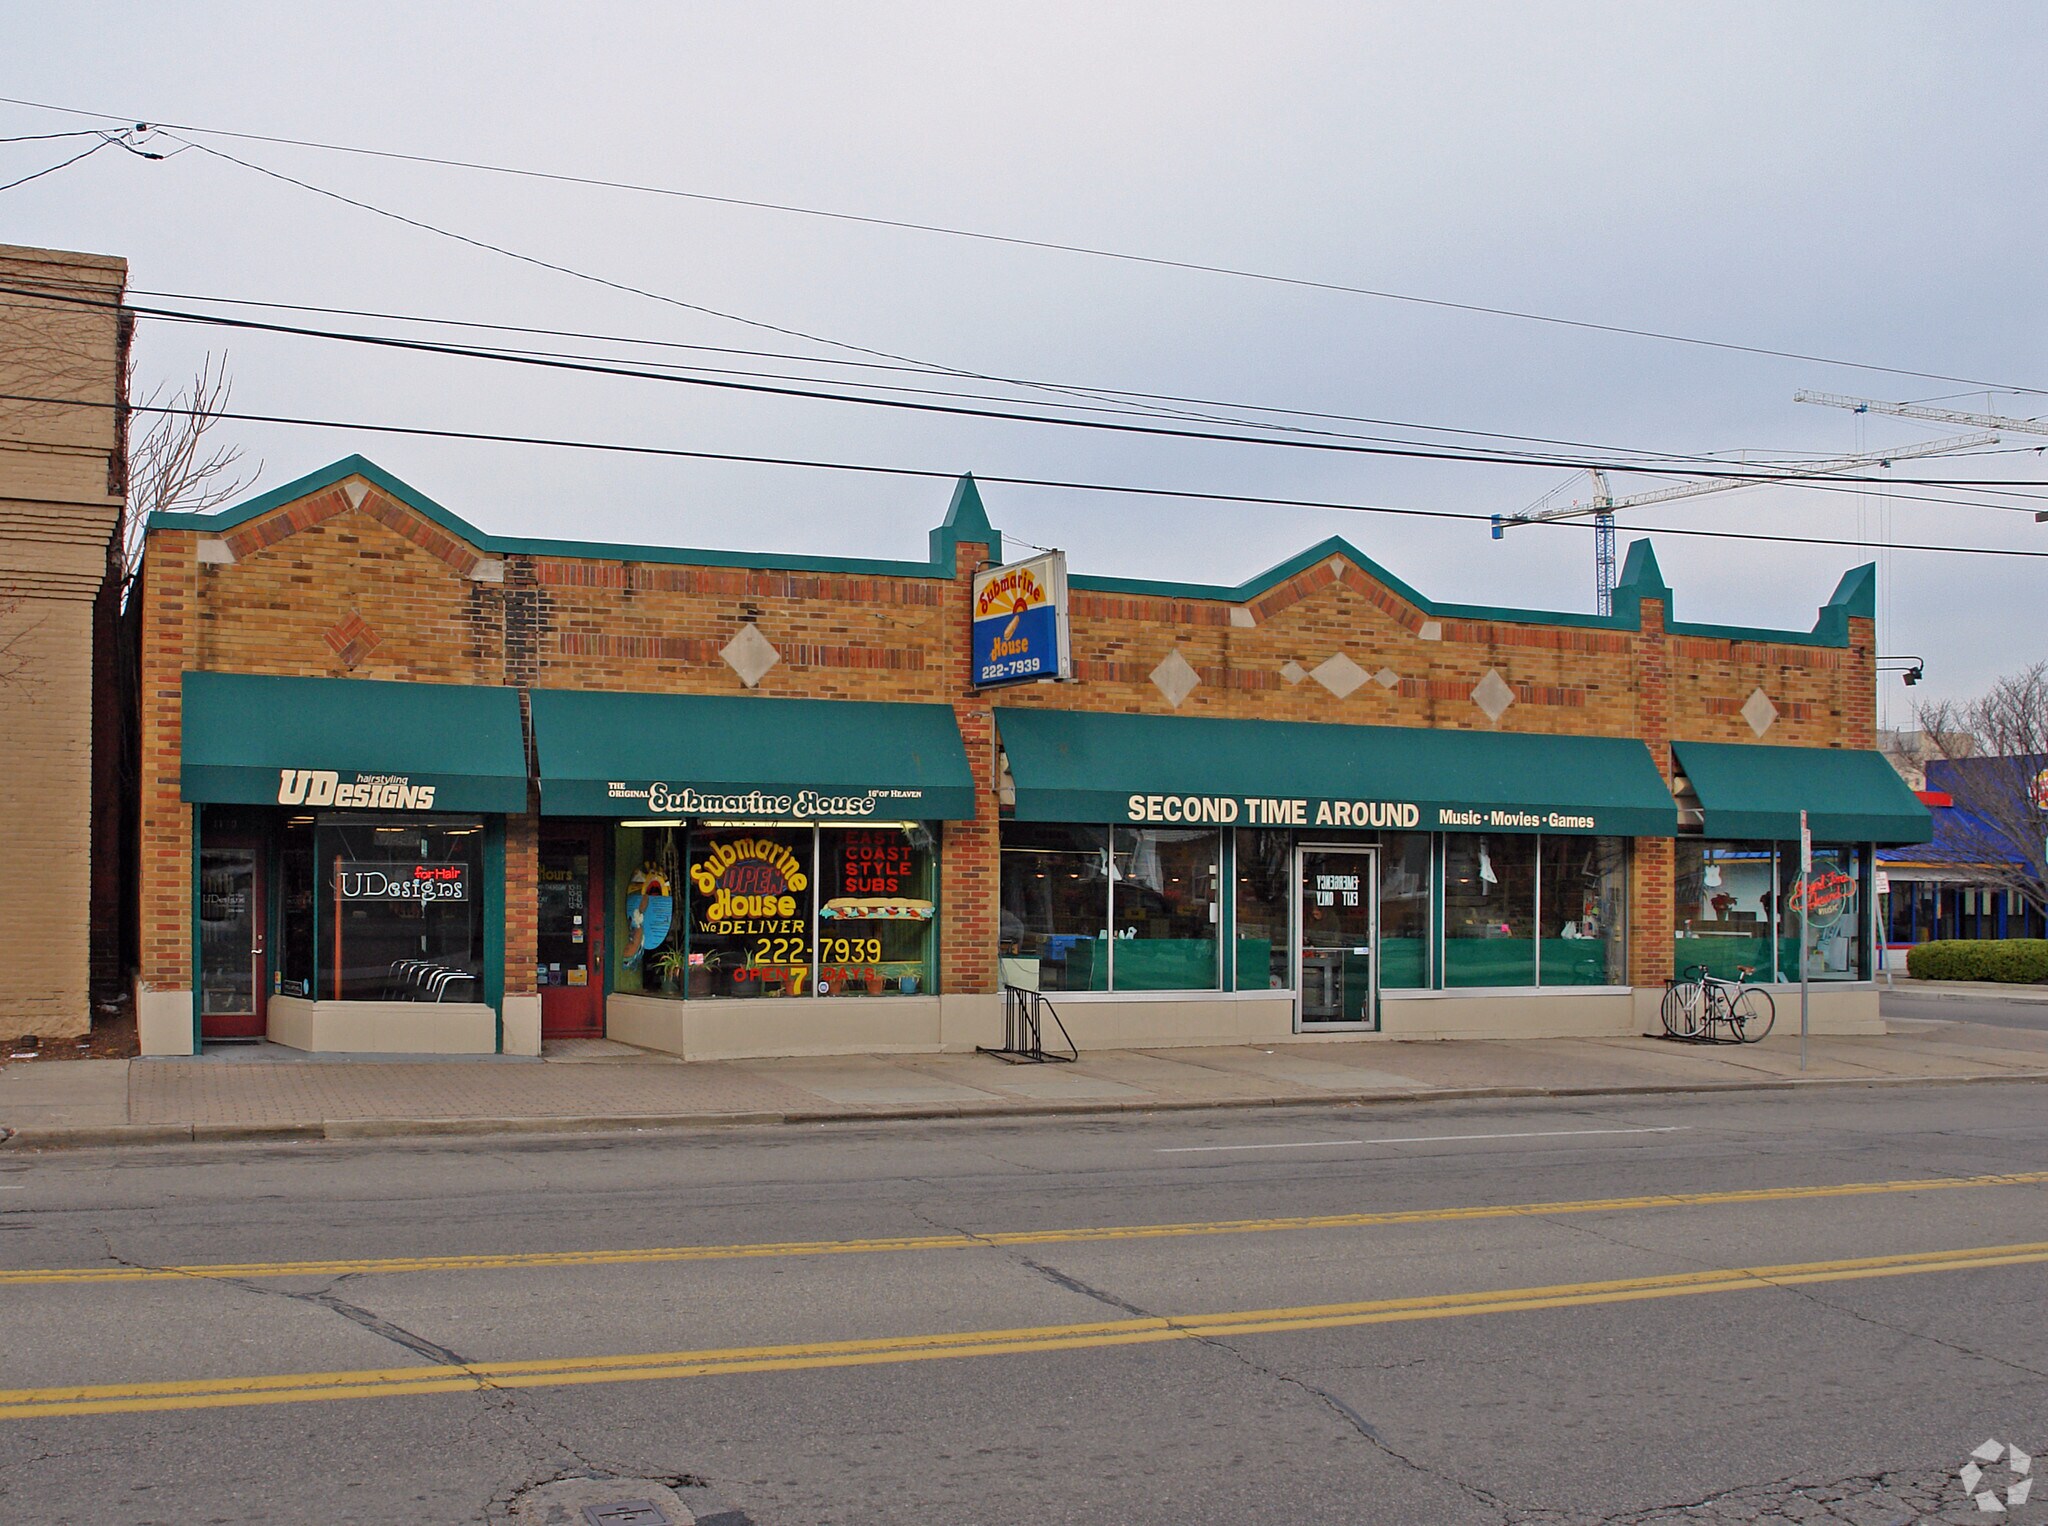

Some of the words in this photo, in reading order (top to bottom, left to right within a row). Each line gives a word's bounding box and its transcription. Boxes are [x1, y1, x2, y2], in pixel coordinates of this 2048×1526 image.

[979, 572, 1040, 614] Submarine
[991, 637, 1028, 661] House
[982, 657, 1040, 679] 222-7939
[356, 773, 409, 786] hairstyling
[608, 782, 626, 790] THE
[608, 790, 650, 798] ORIGINAL
[649, 781, 792, 814] Submarine
[792, 790, 876, 818] House
[890, 790, 922, 798] HEAVEN
[1127, 795, 1239, 823] SECOND
[1244, 798, 1308, 825] TIME
[1315, 800, 1420, 828] AROUND
[1439, 809, 1482, 825] Music
[1490, 811, 1540, 827] Movies
[1548, 812, 1595, 829] Games
[846, 831, 898, 845] EAST
[845, 846, 912, 861] COAST
[690, 838, 808, 895] Submarine
[845, 861, 912, 876] STYLE
[340, 871, 463, 901] UDesigns
[722, 865, 785, 895] OPEN
[845, 877, 899, 892] SUBS
[706, 887, 797, 922] House
[699, 921, 716, 932] We
[717, 920, 805, 935] DELIVER
[733, 967, 789, 982] OPEN
[790, 965, 808, 996] 7
[822, 967, 875, 981] DAYS
